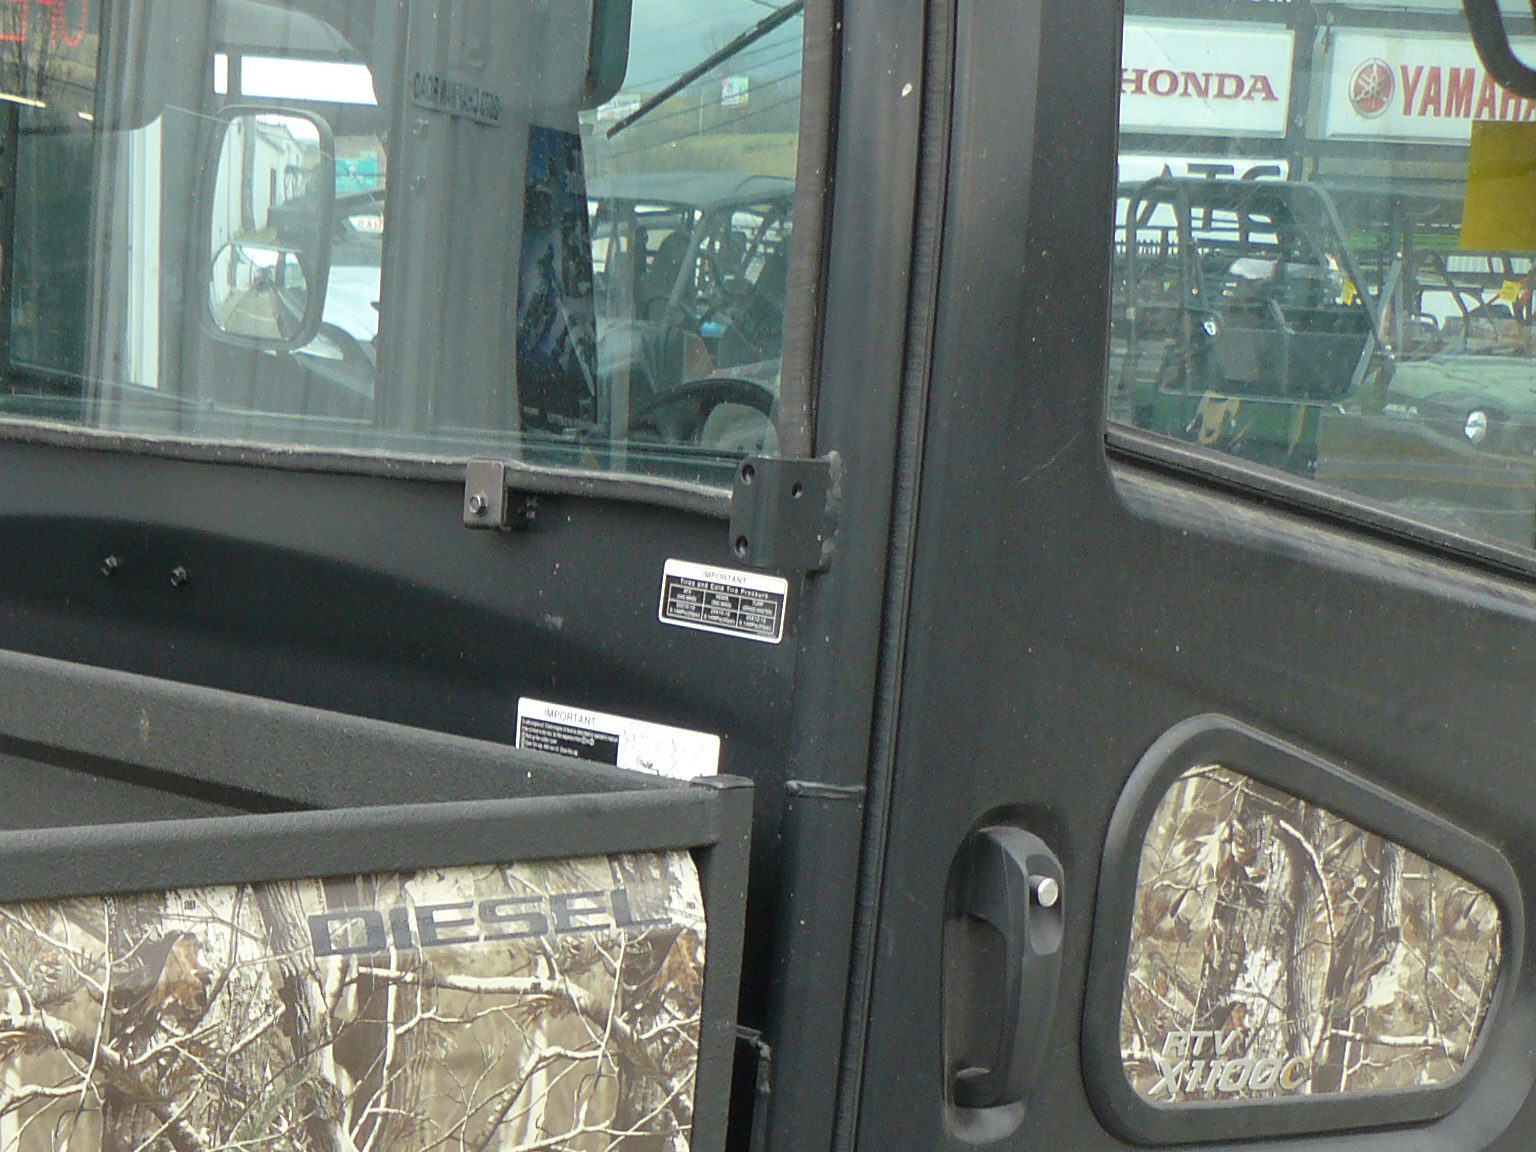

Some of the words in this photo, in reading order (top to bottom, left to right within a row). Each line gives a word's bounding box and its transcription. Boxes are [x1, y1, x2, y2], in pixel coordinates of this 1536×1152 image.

[1121, 68, 1279, 102] HONDA
[702, 570, 747, 585] IMPORTANT
[544, 708, 596, 726] IMPORTANT
[308, 888, 673, 957] DIESEL
[1161, 1030, 1239, 1058] RTV
[1147, 1056, 1312, 1095] X1100C
